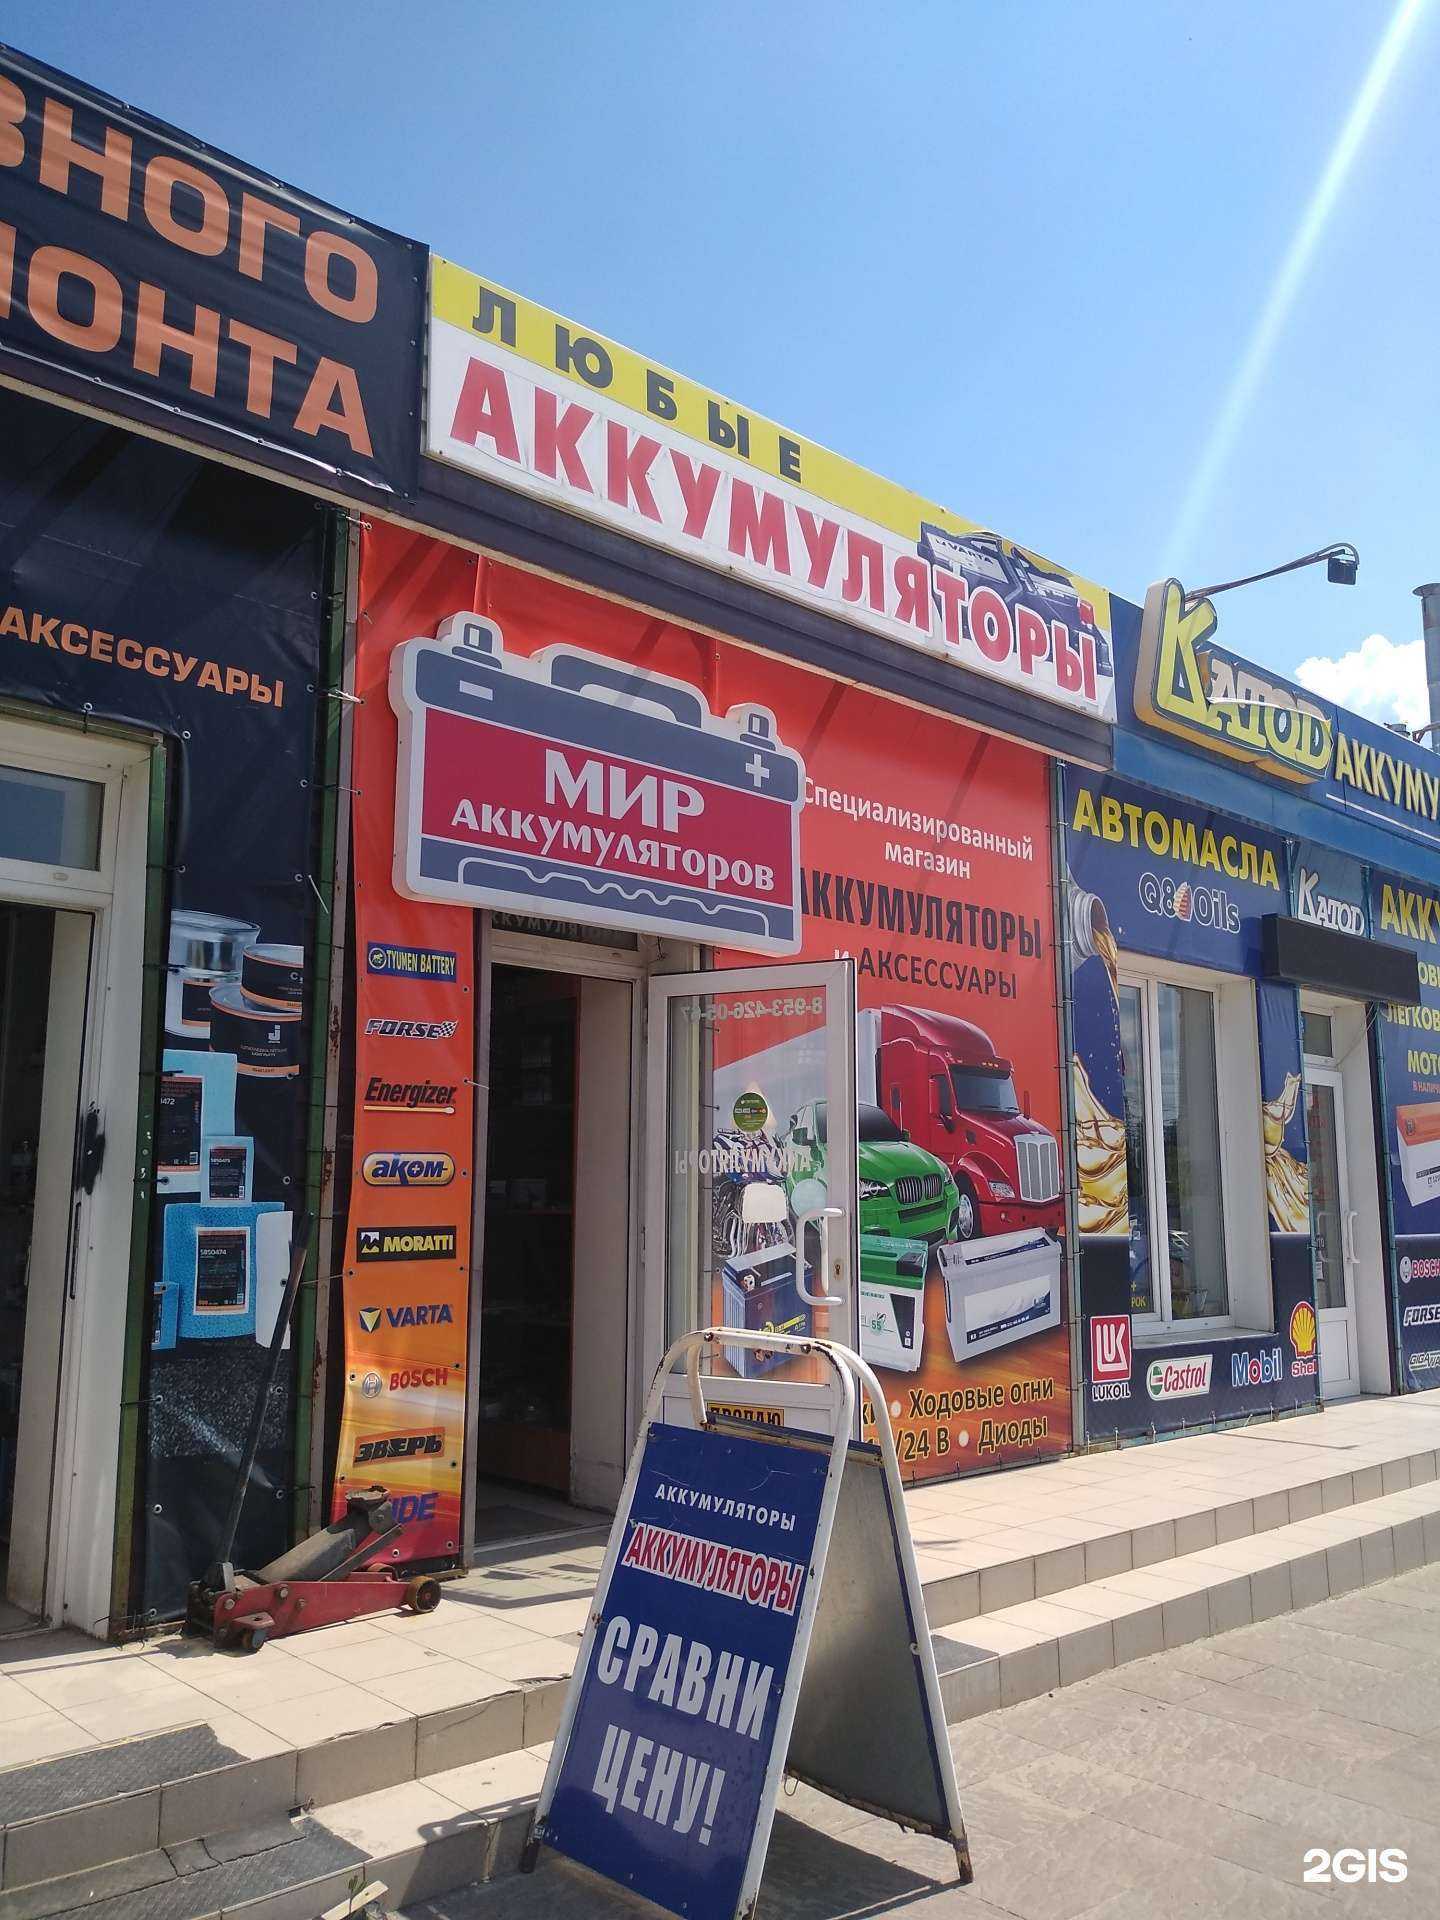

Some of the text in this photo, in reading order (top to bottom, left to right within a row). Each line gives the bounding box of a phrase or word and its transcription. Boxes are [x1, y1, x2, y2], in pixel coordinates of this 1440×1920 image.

[0, 221, 375, 458] ОНТА
[450, 356, 1098, 701] АККУМУЛЯТОРЫ
[0, 606, 285, 707] АКСЕССУАРЫ
[545, 748, 705, 834] МИР
[803, 776, 1034, 862] Специализированный
[1072, 788, 1281, 892] АВТОМАСЛА
[451, 798, 775, 892] Аккумуляторов
[885, 841, 971, 880] магазин
[1195, 886, 1241, 934] Oils
[1380, 883, 1440, 944] АКК
[386, 949, 456, 976] TYUMEN BATTERY
[857, 947, 1017, 1000] АКСЕССУАРЫ
[365, 1018, 442, 1040] FORSE
[364, 1076, 457, 1108] Energizer
[383, 1234, 454, 1253] MORATTI
[386, 1303, 453, 1328] VARTA
[389, 1367, 449, 1391] BOSCH
[1163, 1358, 1207, 1393] Castrol
[1231, 1347, 1283, 1387] Mobil
[909, 1381, 1004, 1421] Ходовые
[1010, 1377, 1054, 1406] огни
[1091, 1382, 1131, 1402] LUKOIL
[977, 1415, 1049, 1456] Диоды
[655, 1483, 796, 1532] АККУМУЛЯТОРЫ
[621, 1522, 804, 1616] АККУМУЛЯТОРЫ
[597, 1615, 775, 1741] СРАВНИ
[592, 1723, 727, 1846] ЦЕНУ!
